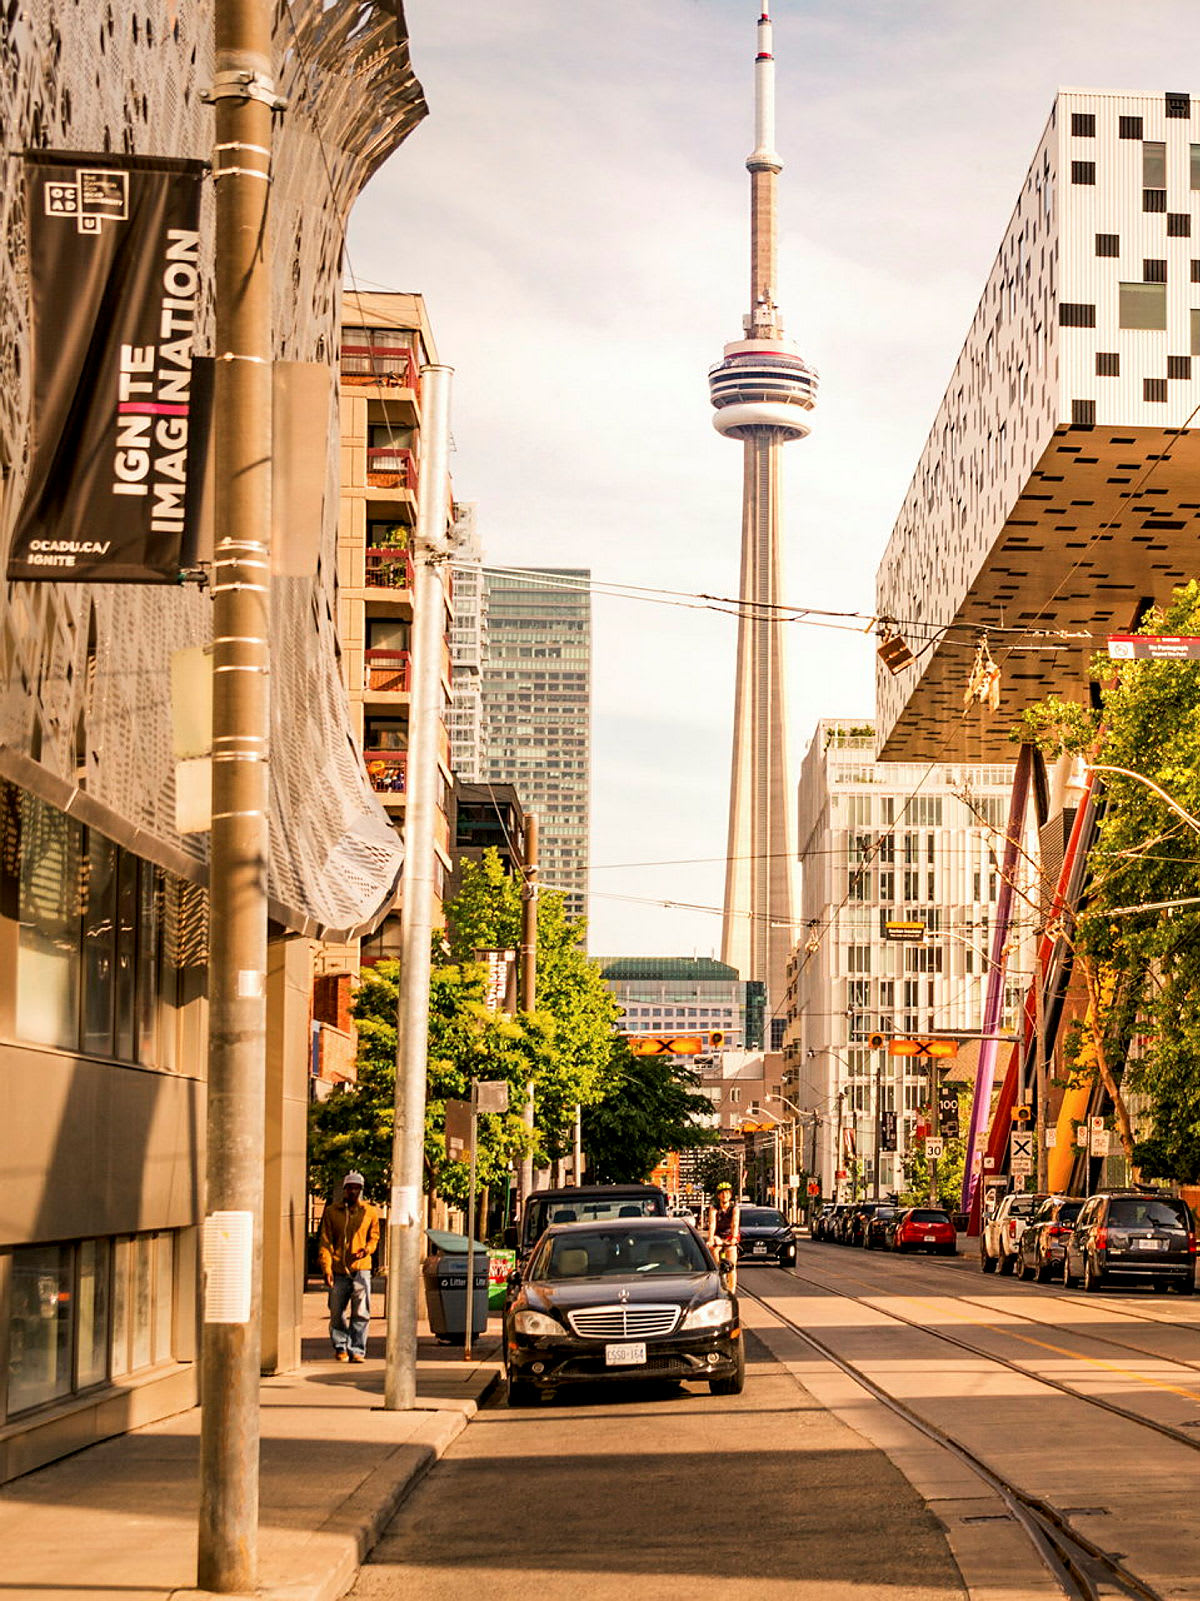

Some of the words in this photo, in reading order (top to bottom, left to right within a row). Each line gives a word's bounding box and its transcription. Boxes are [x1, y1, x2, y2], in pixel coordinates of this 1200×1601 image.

[151, 229, 200, 532] IMAGINATION
[113, 344, 155, 496] IGNITE
[29, 539, 111, 555] OCADU.CA/
[27, 553, 76, 567] IGNITE
[927, 1146, 942, 1157] 30
